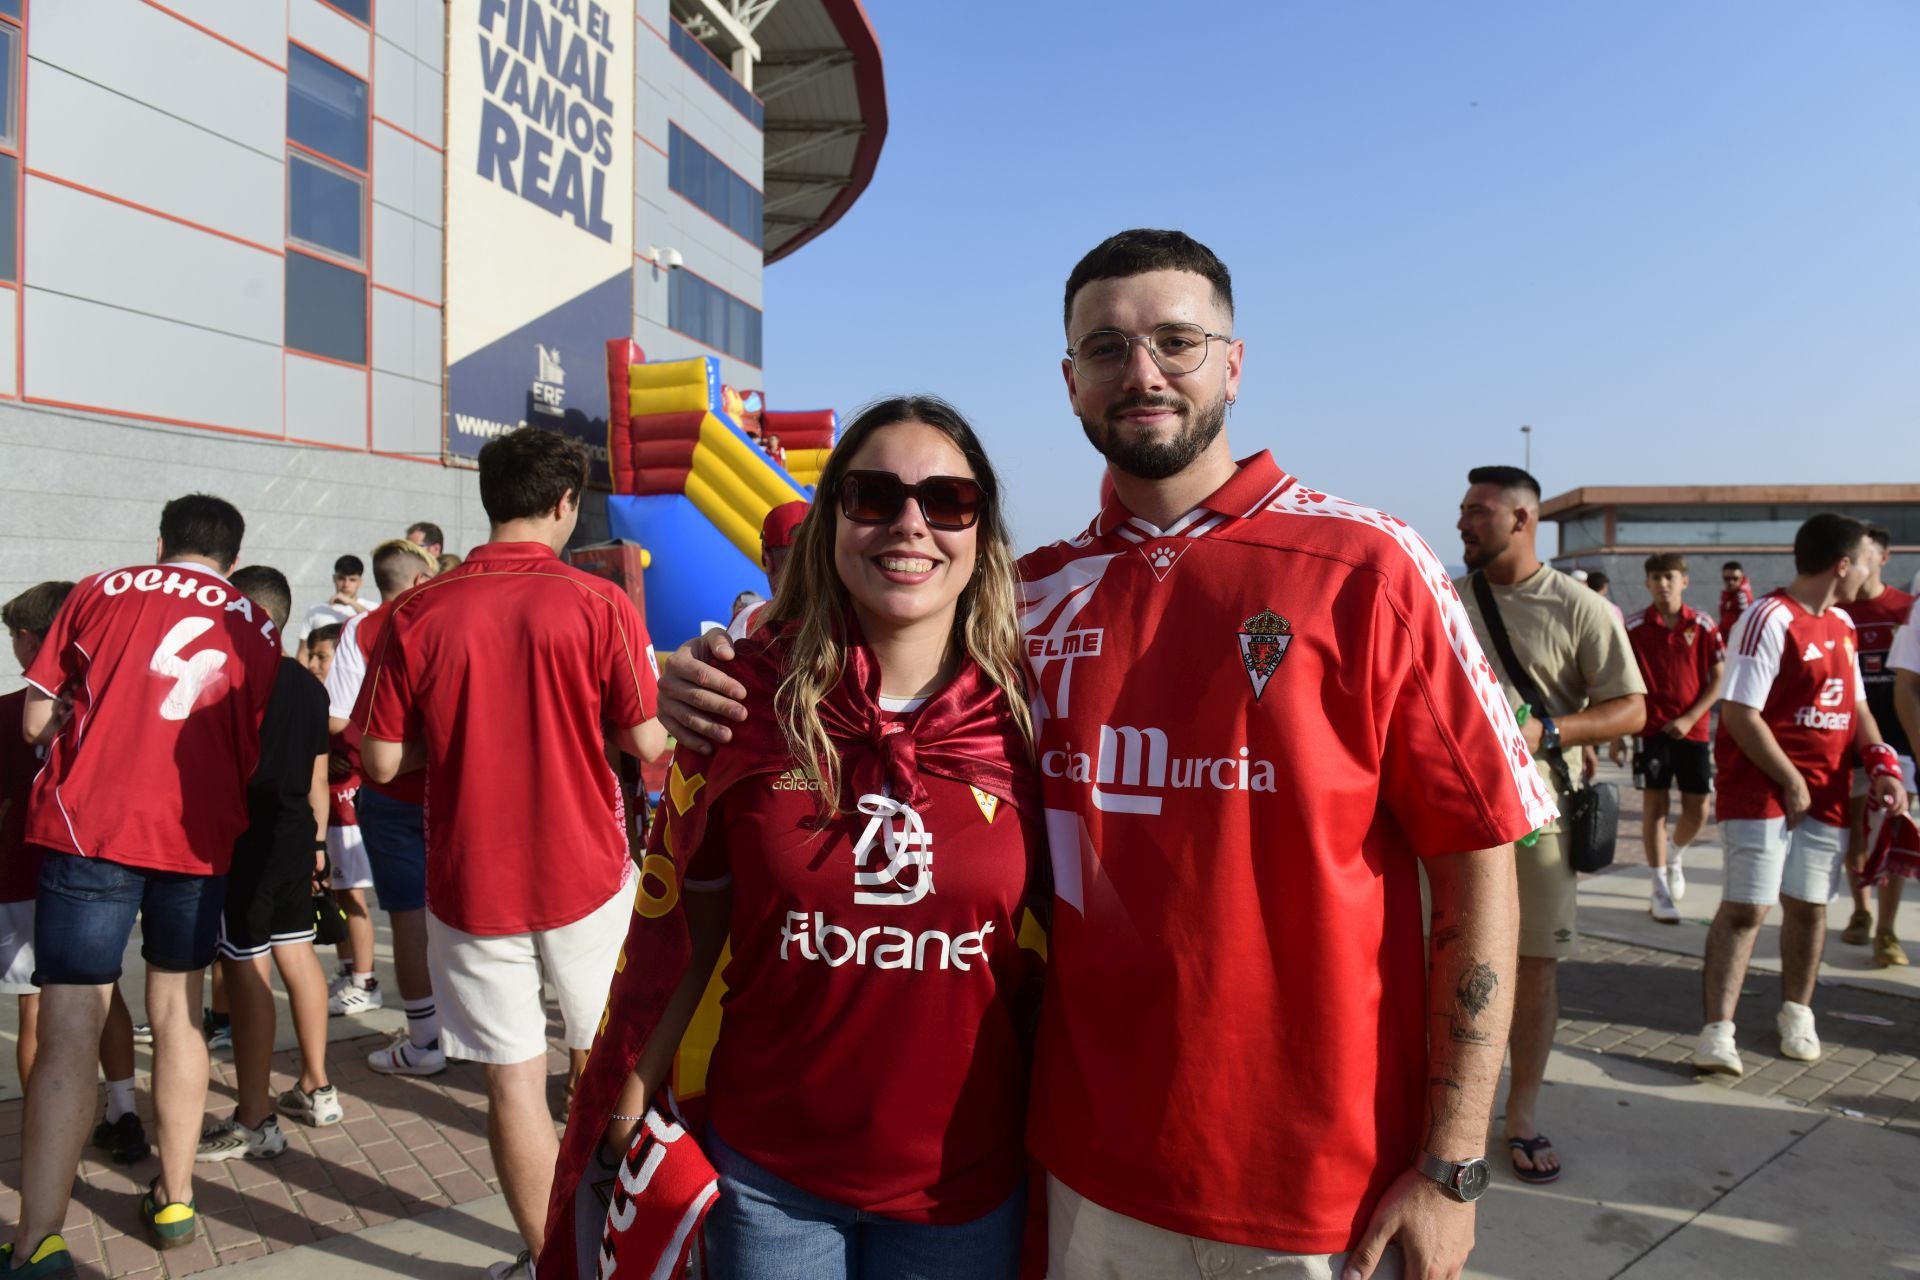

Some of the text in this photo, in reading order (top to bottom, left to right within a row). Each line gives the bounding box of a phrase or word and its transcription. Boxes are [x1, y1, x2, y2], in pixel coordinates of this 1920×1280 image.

[549, 0, 614, 54] A EL
[478, 32, 613, 167] VAMOS
[476, 97, 613, 244] REAL
[533, 381, 566, 406] ERF
[103, 568, 253, 623] OCHOA
[1024, 632, 1100, 658] ELME
[1250, 635, 1279, 643] MURCIA
[150, 616, 228, 720] 4
[780, 910, 996, 971] fibranet
